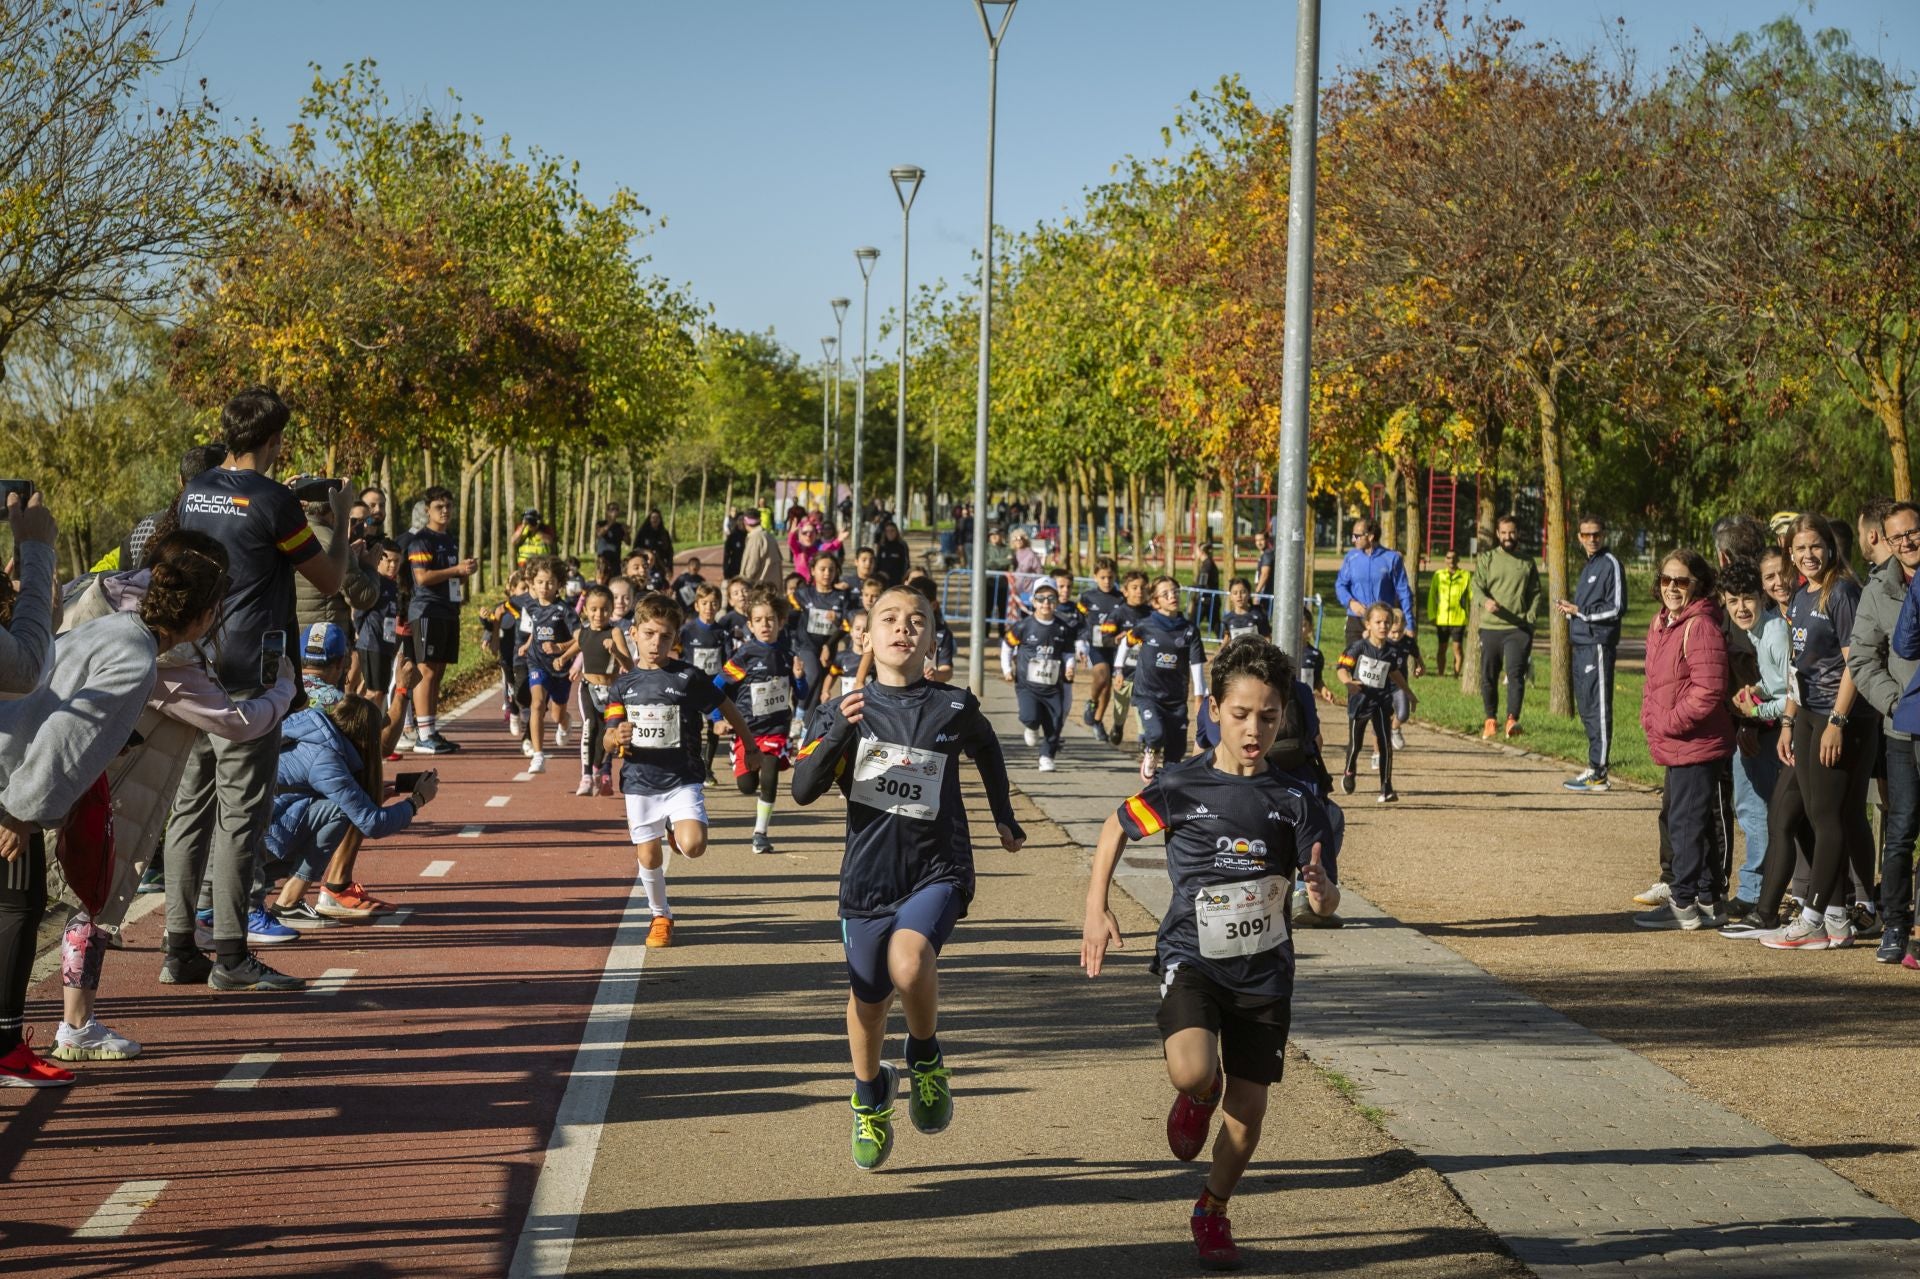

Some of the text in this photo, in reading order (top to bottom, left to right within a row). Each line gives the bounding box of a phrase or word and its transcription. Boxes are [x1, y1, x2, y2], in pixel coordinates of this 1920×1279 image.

[187, 493, 234, 505] POLICIA
[185, 503, 247, 517] NACIONAL
[763, 695, 785, 707] 3010
[638, 727, 666, 738] 3073
[875, 776, 922, 801] 3003
[1216, 836, 1267, 857] 200
[1215, 857, 1255, 866] POLICIA
[1225, 914, 1272, 940] 3097
